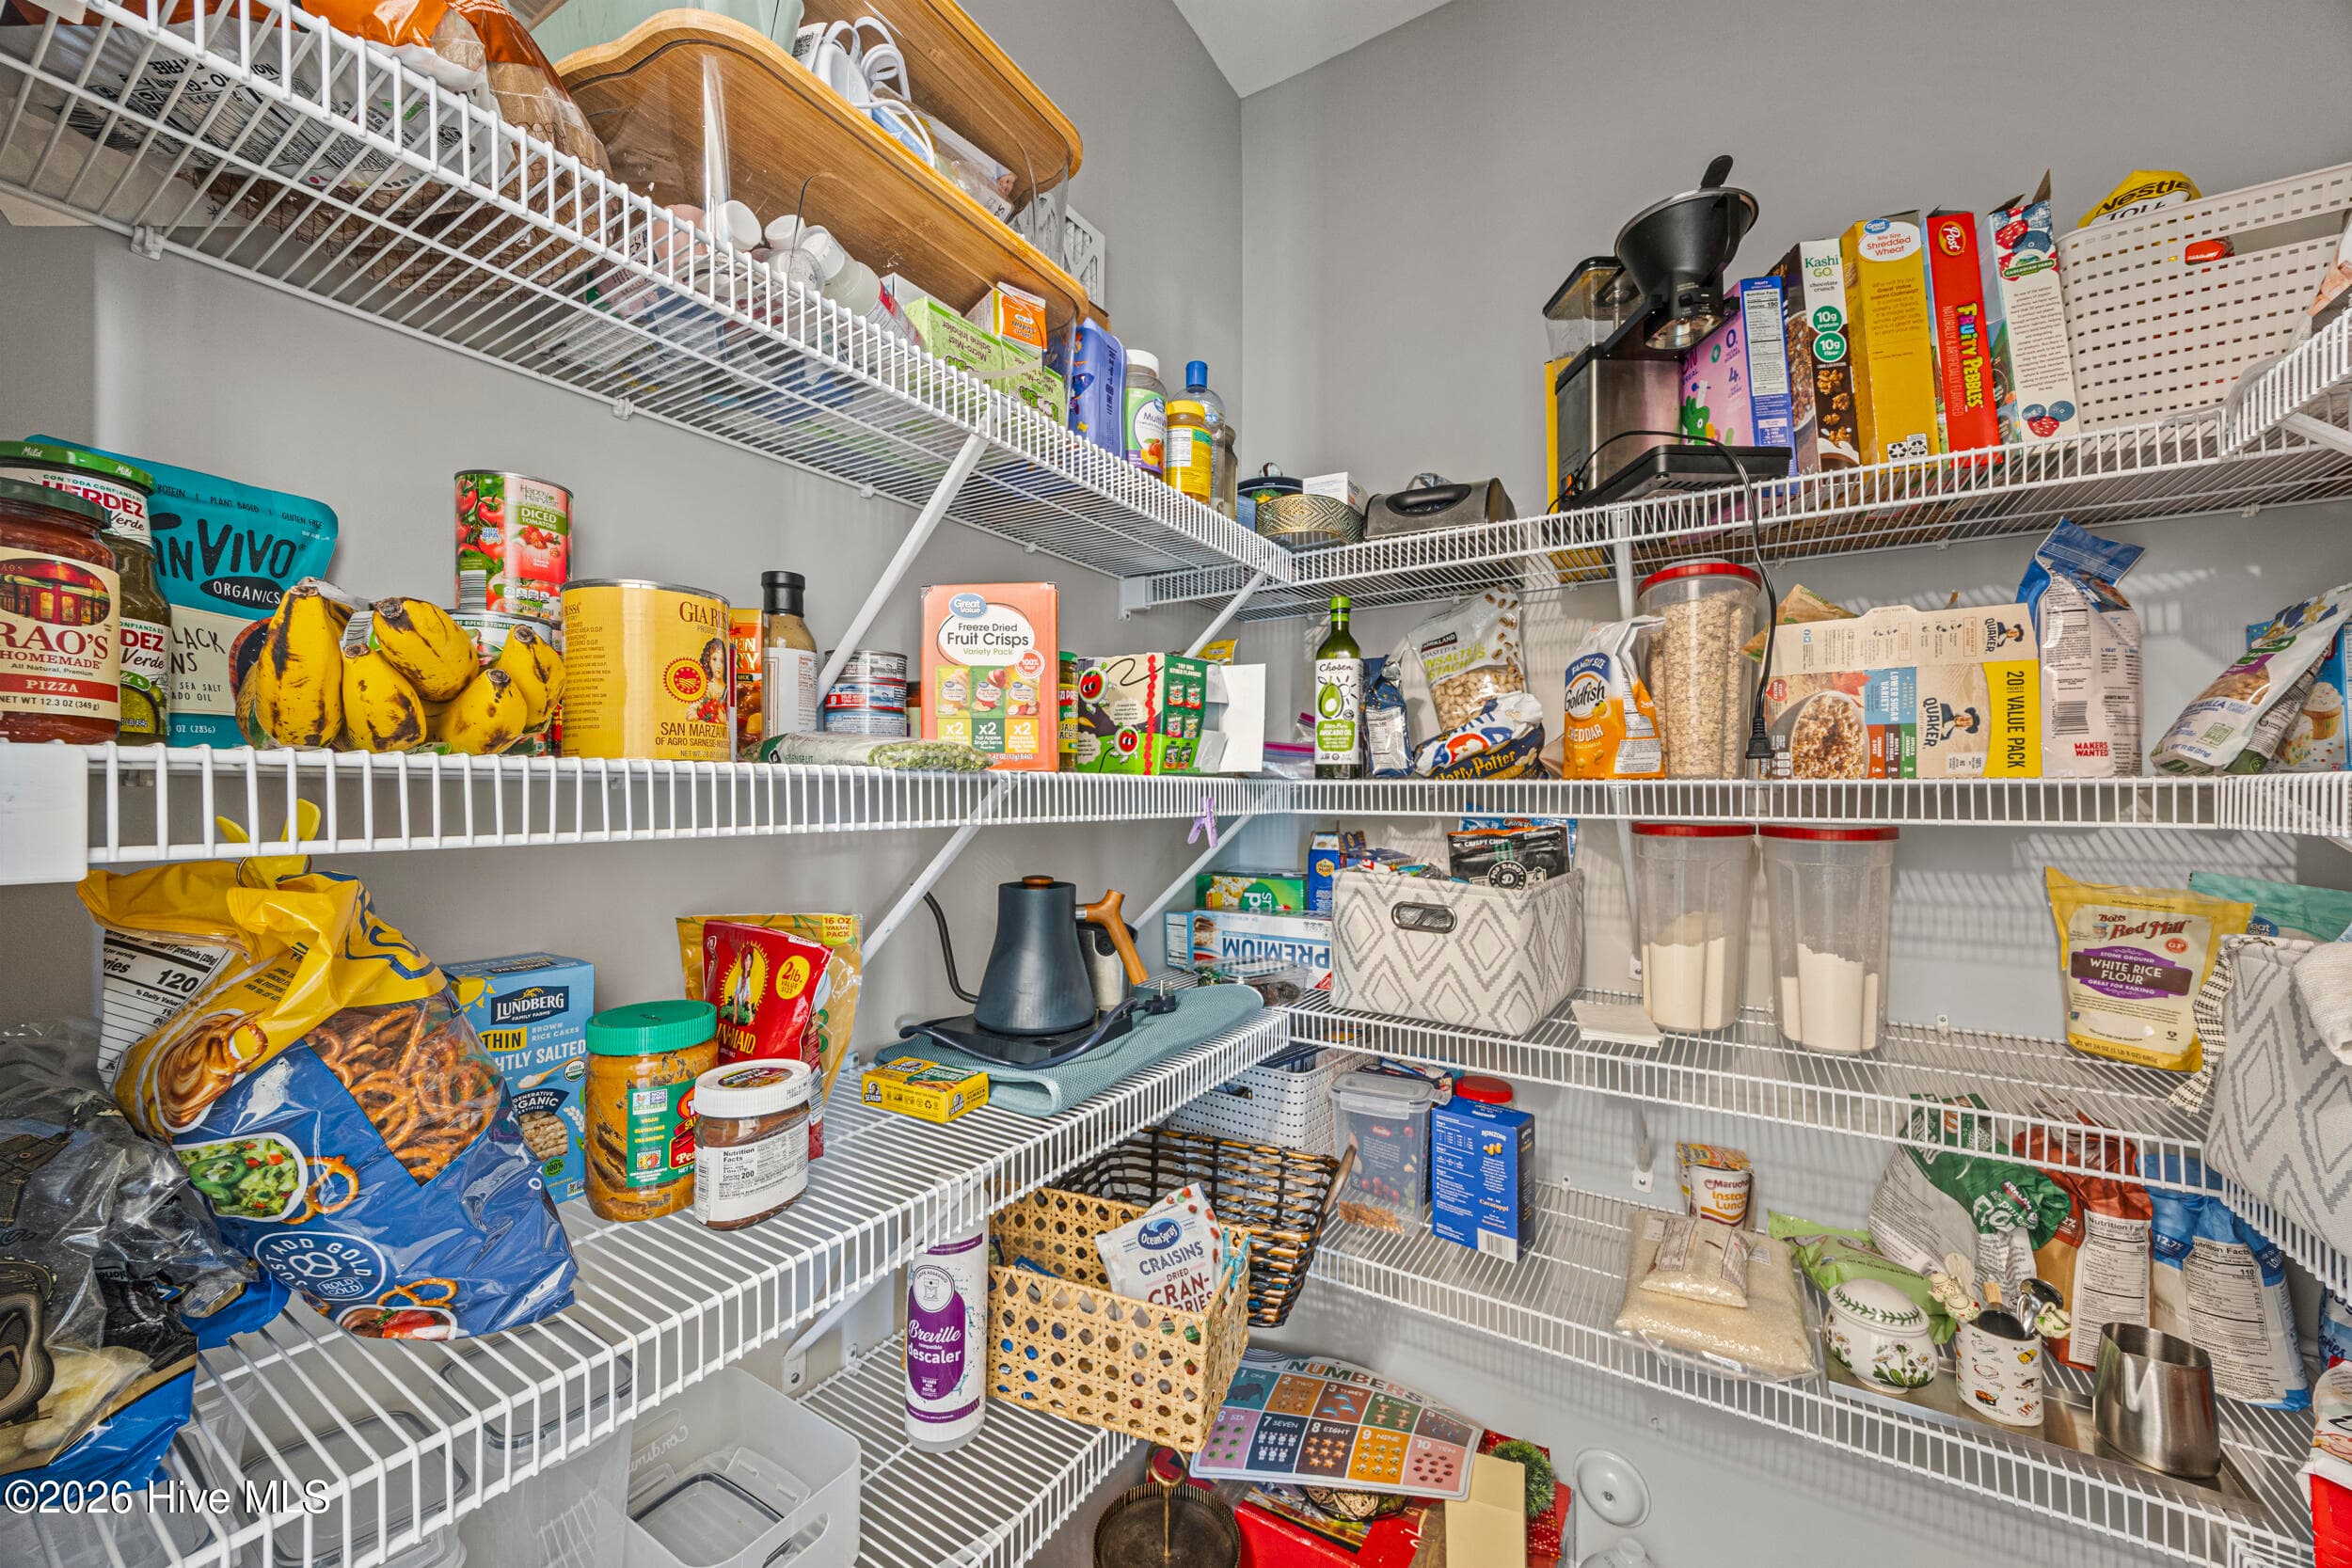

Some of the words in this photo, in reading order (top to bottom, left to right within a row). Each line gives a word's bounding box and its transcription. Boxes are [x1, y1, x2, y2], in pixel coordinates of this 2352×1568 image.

[1867, 236, 1911, 250] Shredded
[1943, 226, 1961, 251] Post
[1875, 245, 1904, 257] Wheat
[1805, 256, 1839, 268] Kashi
[1813, 267, 1833, 277] GO
[1816, 311, 1837, 323] 10g
[949, 336, 987, 362] Micro-Mist
[970, 335, 992, 354] Saline
[1820, 340, 1840, 351] 10g
[22, 446, 43, 458] Mild
[42, 473, 64, 482] CON
[115, 465, 133, 478] Mild
[210, 496, 232, 507] PLANT
[237, 502, 259, 513] BASED
[281, 512, 305, 525] GLUTEN
[309, 518, 324, 529] FREE
[521, 508, 556, 523] DICED
[522, 517, 556, 530] TOMATOES
[481, 531, 500, 540] BPA
[213, 580, 281, 605] ORGANICS
[954, 598, 981, 610] Great
[961, 605, 981, 614] Value
[679, 602, 706, 625] GIA
[958, 623, 990, 632] Freeze
[992, 622, 1018, 632] Dried
[0, 621, 108, 659] RAO'S
[947, 632, 979, 645] Fruit
[983, 632, 1029, 647] Crisps
[1984, 617, 1995, 652] QUAKER
[121, 647, 165, 669] Verde
[962, 647, 994, 657] Variety
[997, 648, 1013, 657] Pack
[1, 650, 101, 670] HOMEMADE
[1319, 662, 1353, 672] Chosen
[1571, 658, 1591, 675] FAMILY
[1592, 657, 1606, 670] SIZE
[11, 662, 24, 671] All
[27, 664, 61, 674] Natural,
[63, 668, 93, 677] Premium
[1890, 672, 1899, 697] LOWER
[2007, 671, 2025, 686] 20
[26, 679, 79, 693] PIZZA
[180, 683, 197, 691] SEA
[202, 683, 221, 692] SALT
[0, 695, 18, 704] NET
[21, 696, 36, 705] WT
[40, 698, 60, 706] 12.3
[197, 692, 213, 703] OIL
[1565, 680, 1605, 712] Goldfish
[1881, 681, 1889, 712] VARIETY
[1890, 698, 1899, 722] SUGAR
[2007, 695, 2025, 734] VALUE
[661, 722, 685, 736] SAN
[946, 722, 963, 734] x2
[979, 722, 996, 735] x2
[1014, 722, 1031, 734] x2
[1922, 697, 1940, 747] QUAKER
[176, 725, 186, 734] OZ
[1567, 723, 1604, 741] CHEDDAR
[656, 736, 666, 746] OF
[668, 737, 687, 747] AGRO
[2074, 741, 2108, 750] MAKERS
[2007, 737, 2026, 768] PACK
[2075, 749, 2108, 757] WANTED
[1471, 751, 1516, 776] Potter
[1464, 839, 1488, 847] CRISPY
[1490, 866, 1501, 879] POP
[1502, 863, 1524, 879] DADDY
[2098, 913, 2126, 922] Bob's
[2108, 922, 2148, 941] Red
[2145, 920, 2187, 939] Mill
[2249, 922, 2271, 933] eat
[175, 946, 200, 959] pretzels
[2123, 955, 2154, 963] GROUND
[782, 961, 803, 983] 2lb.
[2090, 958, 2129, 972] WHITE
[2133, 964, 2163, 977] RICE
[104, 958, 131, 974] ries
[157, 969, 199, 993] 120
[2101, 970, 2143, 985] FLOUR
[781, 981, 799, 990] VALUE
[2124, 985, 2155, 994] BAKING
[143, 990, 159, 1002] Daily
[496, 993, 564, 1022] LUNDBERG
[512, 1013, 532, 1022] FAMILY
[532, 1022, 563, 1034] BROWN
[532, 1032, 548, 1041] RICE
[550, 1026, 580, 1039] CAKES
[482, 1032, 521, 1050] THIN
[496, 1047, 540, 1072] HTLY
[542, 1039, 586, 1063] SALTED
[723, 1148, 755, 1157] Nutrition
[546, 1164, 564, 1174] 100%
[2089, 1217, 2128, 1230] Nutrition
[1142, 1233, 1162, 1245] Ocean
[1160, 1225, 1178, 1243] Spray
[2155, 1234, 2183, 1250] 12.7%
[271, 1239, 314, 1255] ADD
[2226, 1246, 2250, 1256] Facts
[326, 1243, 372, 1276] GOLD
[1139, 1241, 1205, 1275] CRAISINS
[266, 1255, 308, 1286] JUST
[1167, 1267, 1189, 1282] DRIED
[322, 1278, 354, 1290] ROLD
[327, 1284, 359, 1296] GOLD
[1148, 1273, 1210, 1306] CRAN-
[909, 1320, 961, 1343] Breville
[908, 1342, 961, 1364] descaler
[1240, 1369, 1246, 1378] 1
[1250, 1372, 1267, 1381] ONE
[1282, 1376, 1290, 1386] 2
[1289, 1361, 1423, 1402] NUMBERS
[1328, 1384, 1337, 1393] 3
[1341, 1387, 1364, 1397] THREE
[1375, 1394, 1385, 1402] 4
[1389, 1399, 1410, 1408] FOUR
[1263, 1417, 1273, 1427] 7
[1272, 1420, 1298, 1429] SEVEN
[1311, 1422, 1320, 1433] 8
[1323, 1426, 1350, 1435] EIGHT
[1362, 1430, 1372, 1440] 9
[1376, 1433, 1400, 1443] NINE
[1416, 1439, 1431, 1450] 10
[1437, 1445, 1456, 1454] TEN
